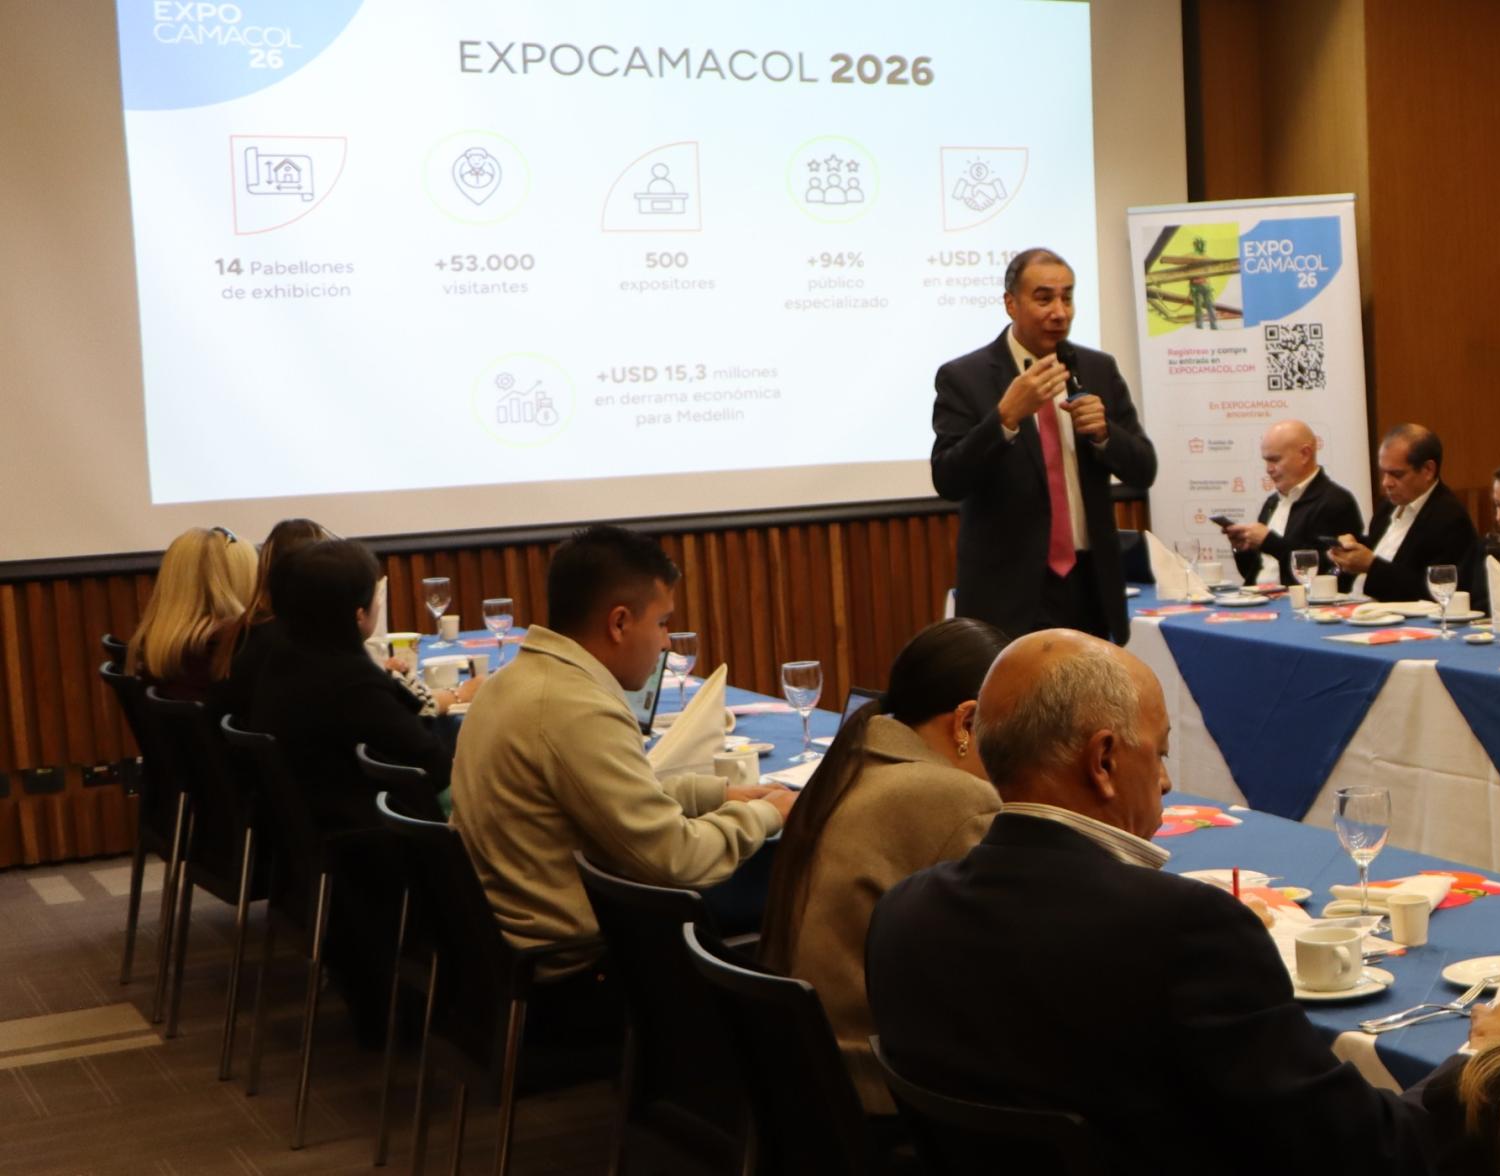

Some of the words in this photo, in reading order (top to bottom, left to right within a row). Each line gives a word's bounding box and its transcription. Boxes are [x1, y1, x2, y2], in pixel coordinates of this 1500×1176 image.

[153, 1, 242, 24] EXPO
[153, 22, 303, 48] CAMACOL
[249, 48, 284, 69] 26
[459, 39, 819, 83] EXPOCAMACOL
[829, 52, 935, 87] 2026
[1243, 239, 1293, 258] EXPO
[214, 258, 244, 276] 14
[250, 260, 355, 276] Pabellones
[434, 253, 536, 273] +53.000
[645, 251, 689, 269] 500
[807, 251, 865, 269] +94%
[927, 250, 981, 267] +USD
[1243, 254, 1328, 274] CAMACOL
[442, 281, 529, 296] visitantes
[619, 276, 716, 293] expositores
[807, 275, 865, 293] público
[922, 277, 942, 288] en
[1297, 272, 1318, 289] 26
[221, 285, 247, 300] de
[251, 283, 351, 300] exhibición
[937, 293, 956, 307] de
[783, 296, 889, 311] especializado
[596, 365, 659, 384] +USD
[665, 364, 708, 385] 15,3
[712, 364, 778, 380] millones
[1168, 363, 1256, 375] EXPOCAMACOL.COM
[594, 395, 616, 407] en
[620, 389, 688, 406] derrama
[691, 386, 782, 404] económica
[1221, 400, 1289, 410] EXPOCAMACOL
[635, 413, 672, 429] para
